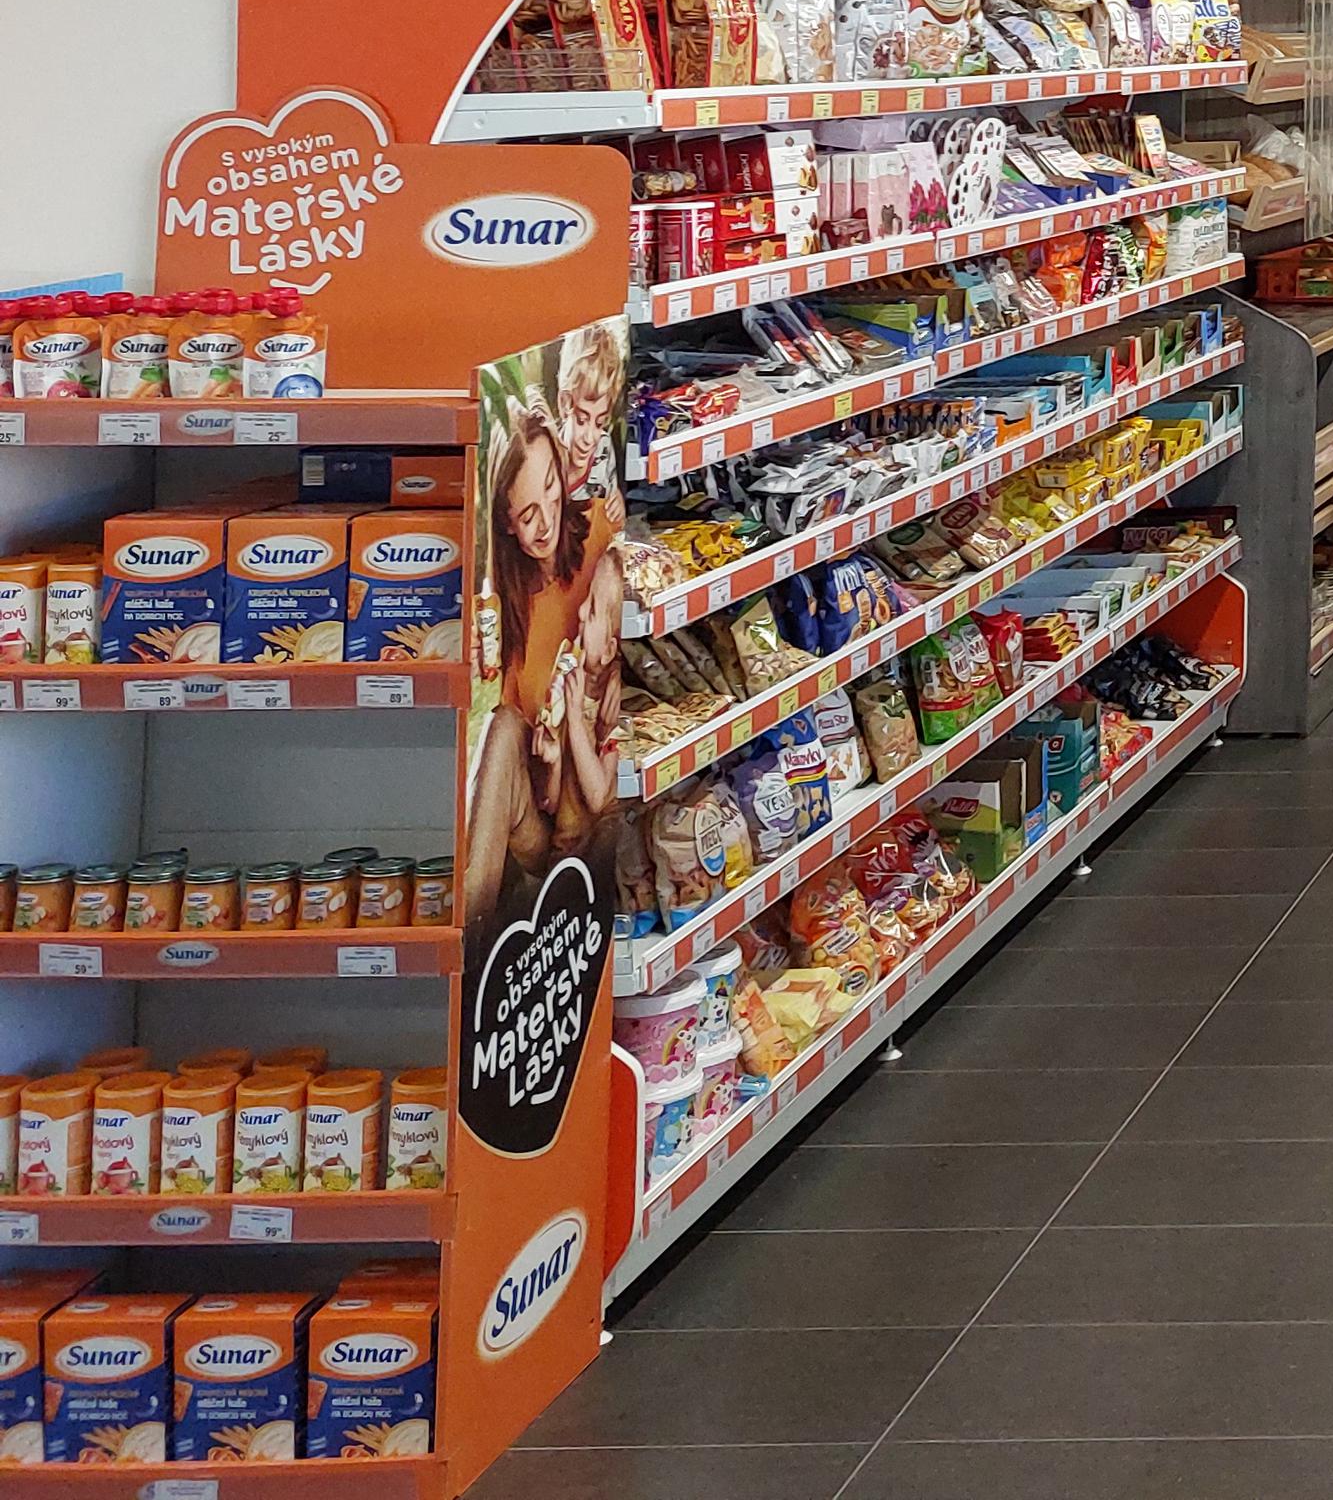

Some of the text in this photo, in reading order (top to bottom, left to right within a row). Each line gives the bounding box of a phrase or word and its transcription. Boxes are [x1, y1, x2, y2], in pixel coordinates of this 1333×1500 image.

[222, 131, 334, 168] S vysokým
[207, 144, 360, 197] obsahem
[164, 153, 404, 238] Mateřské
[442, 206, 577, 248] Sunar
[230, 217, 366, 276] Lásky
[31, 338, 83, 355] Sunar
[119, 337, 168, 355] Sunar
[187, 337, 239, 354] Sunar
[259, 336, 310, 353] Sunar
[125, 543, 199, 568] Sunar
[249, 543, 323, 566] Sunar
[373, 541, 449, 565] Sunar
[516, 908, 568, 972] vysokým
[165, 947, 213, 961] Sunar
[498, 912, 581, 1022] obsahem
[473, 912, 603, 1089] Mateřské
[508, 992, 583, 1108] Lásky
[95, 1115, 129, 1128] unar
[239, 1111, 284, 1126] Sunar
[392, 1109, 433, 1124] Sunar
[492, 1231, 577, 1337] Sunar
[66, 1345, 142, 1369] Sunar
[196, 1344, 271, 1369] Sunar
[332, 1343, 407, 1366] Sunar
